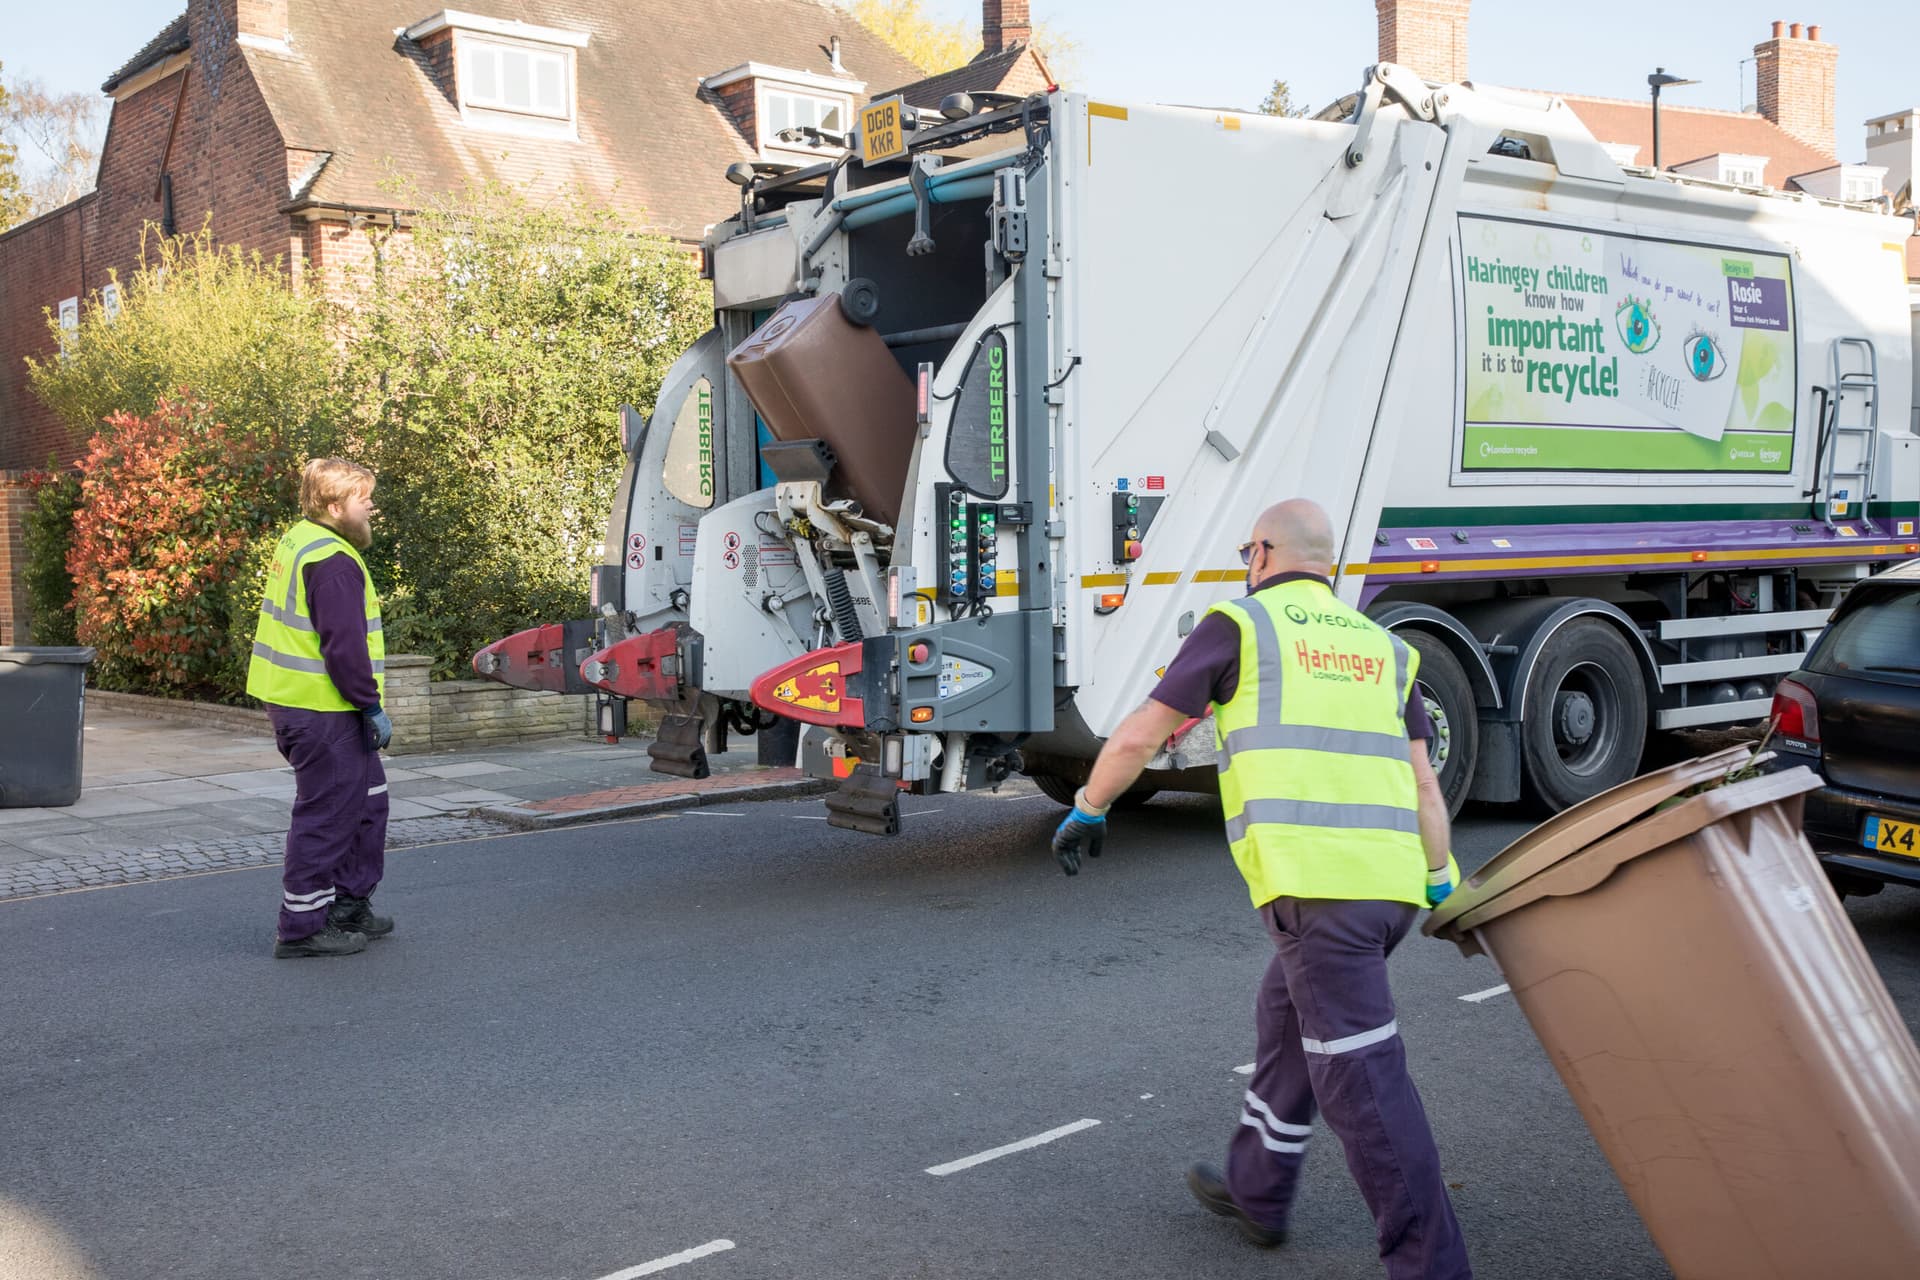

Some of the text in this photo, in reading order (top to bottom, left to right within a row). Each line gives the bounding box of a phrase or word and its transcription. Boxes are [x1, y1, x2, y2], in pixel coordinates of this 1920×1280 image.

[866, 106, 894, 133] DG18
[870, 130, 894, 156] KKR
[1467, 256, 1608, 295] Haringey children
[1525, 288, 1584, 312] know how
[1731, 280, 1763, 304] Rosie
[1487, 305, 1605, 357] important
[1482, 352, 1619, 403] it is to recycle!
[989, 346, 1005, 482] TERBERG
[1309, 611, 1374, 632] VEOLIA
[1295, 640, 1386, 685] Haringey
[1312, 671, 1351, 682] LONDON
[1881, 823, 1920, 851] X4
